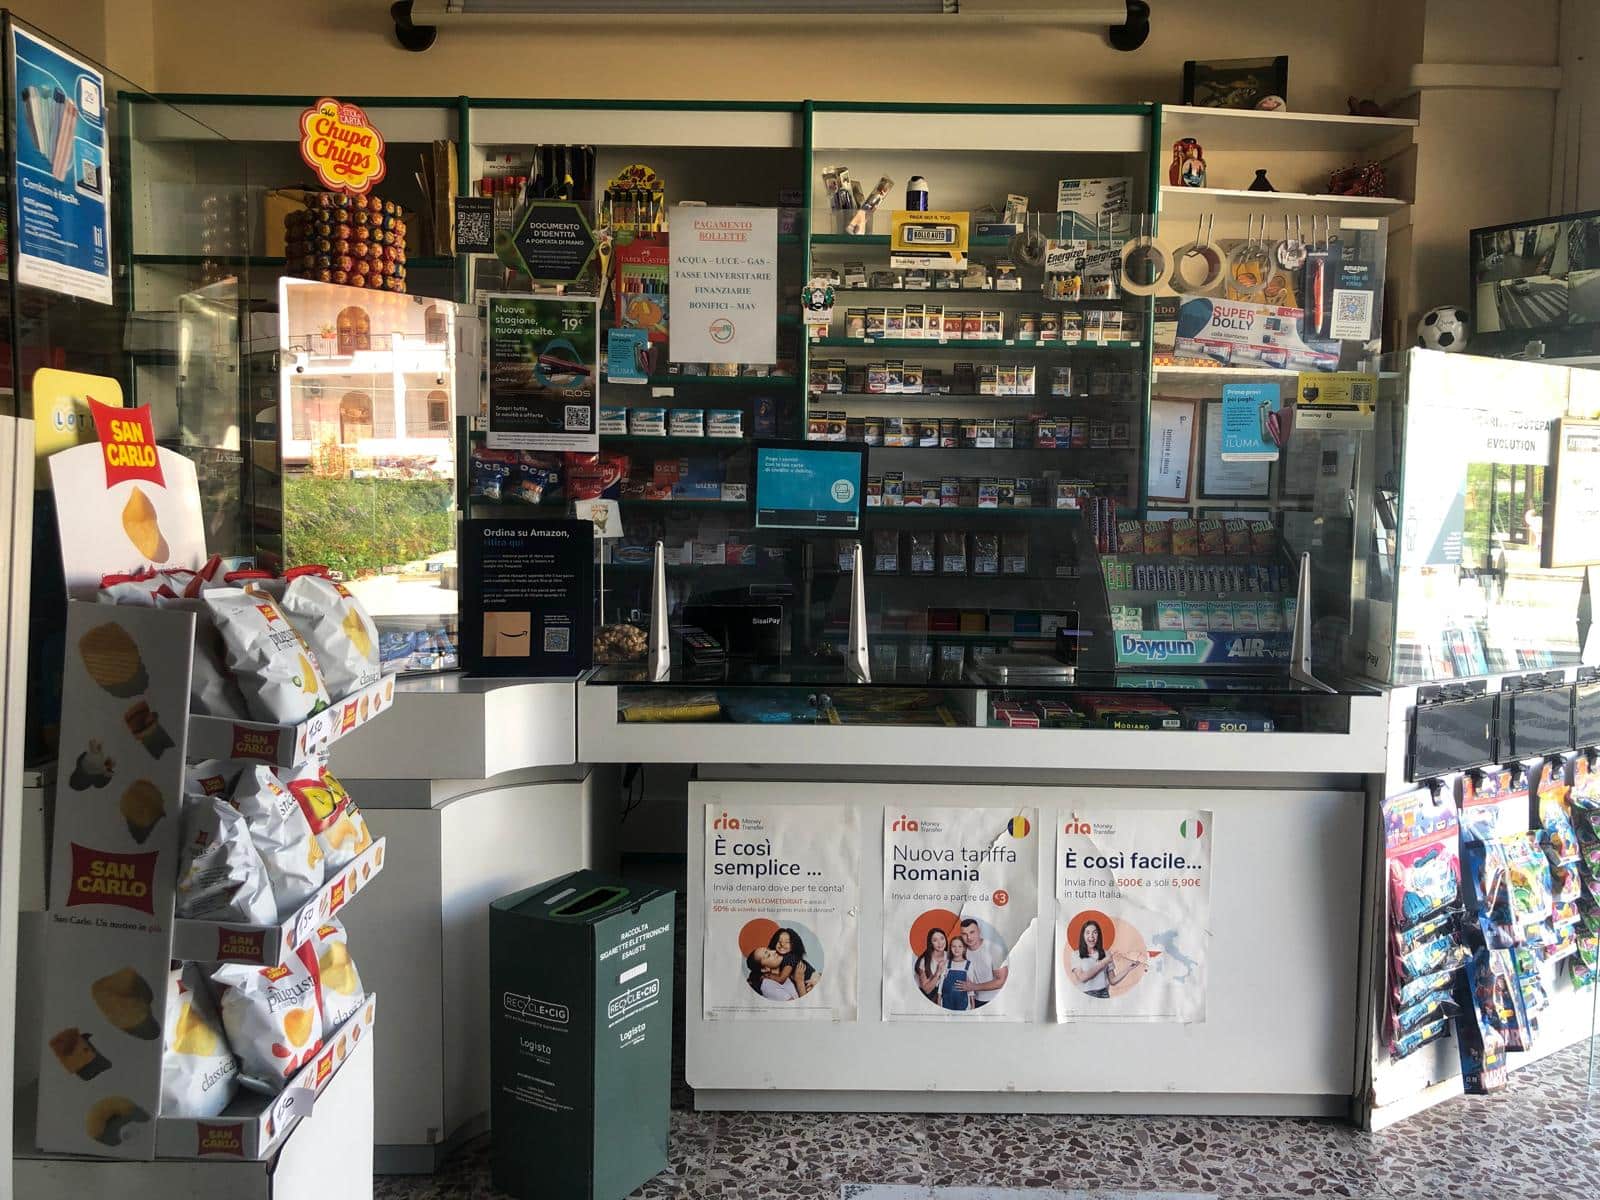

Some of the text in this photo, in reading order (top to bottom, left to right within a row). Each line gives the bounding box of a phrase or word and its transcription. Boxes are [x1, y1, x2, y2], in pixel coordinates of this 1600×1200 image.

[315, 118, 372, 149] Chupa
[312, 138, 371, 175] Chups
[530, 222, 581, 231] DOCUMENTO
[694, 219, 752, 230] PAGAMENTO
[699, 231, 748, 242] BOLLETTE
[914, 230, 946, 240] BOLLO AUTO
[676, 256, 765, 265] ACQUA LUCE GAS
[1047, 249, 1086, 264] Energizer
[1343, 265, 1368, 274] amazon
[674, 271, 772, 281] TASSE UNIVERSITARIE
[695, 286, 752, 295] FINANZIARIE
[495, 304, 525, 314] Nuova
[689, 301, 757, 310] BONIFICI MAV
[1213, 305, 1255, 320] SUPER
[495, 315, 539, 326] stagione,
[1212, 316, 1254, 331] DOLLY
[495, 325, 556, 336] nuove scelte.
[562, 389, 591, 398] IQOS
[111, 419, 145, 443] SAN
[1226, 439, 1260, 448] ILUMA
[106, 443, 157, 467] CARLO
[483, 528, 570, 539] Ordina su Amazon,
[1122, 634, 1265, 660] Daygum AIR
[1220, 723, 1248, 732] SOLO
[243, 733, 268, 744] SAN
[236, 742, 274, 755] CARLO
[713, 812, 740, 830] ria
[892, 814, 919, 832] ria
[1064, 817, 1092, 835] ria
[714, 834, 771, 856] È così
[893, 844, 1017, 863] Nuova tariffa
[1065, 847, 1202, 869] È così facile...
[88, 860, 135, 879] SAN
[714, 859, 801, 879] semplice
[893, 864, 980, 881] Romania
[76, 878, 148, 897] CARLO
[713, 883, 845, 893] Invia denaro dove per te conta!
[1064, 877, 1086, 887] Invia
[1088, 877, 1106, 887] fino
[1117, 878, 1143, 887] 500€
[1145, 879, 1152, 887] a
[1154, 878, 1169, 887] soli
[1171, 878, 1201, 888] 5,90€
[891, 892, 911, 900] Invia
[913, 892, 941, 901] denaro
[950, 893, 977, 903] partire
[978, 893, 990, 902] da
[1064, 890, 1073, 898] in
[1075, 890, 1097, 898] tutta
[620, 923, 649, 941] RACCOLTA
[599, 924, 670, 961] SIGARETTE ELETTRONICHE
[221, 944, 261, 954] CARLO
[621, 943, 647, 960] ESAUSTE
[620, 1023, 646, 1042] Logista
[519, 1036, 552, 1055] Logista
[208, 1130, 234, 1140] SAN
[201, 1139, 240, 1149] CARLO
